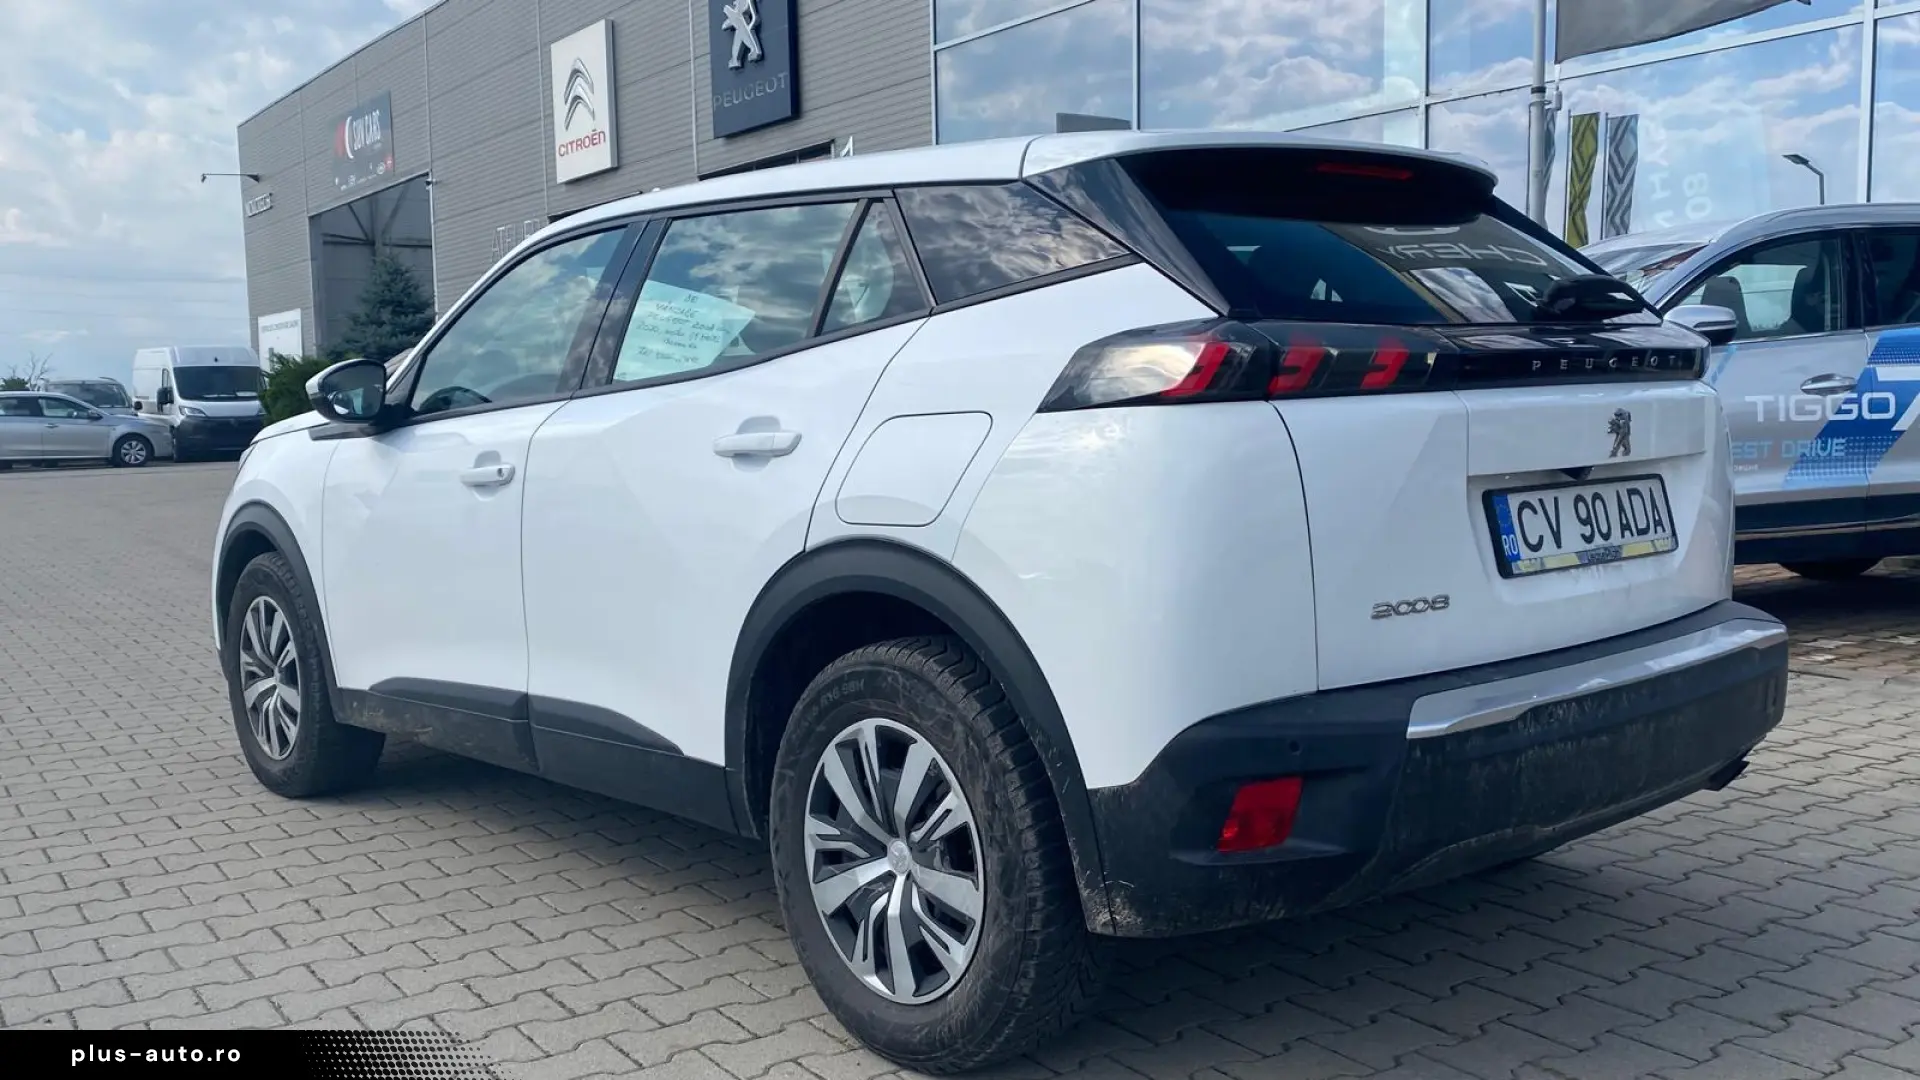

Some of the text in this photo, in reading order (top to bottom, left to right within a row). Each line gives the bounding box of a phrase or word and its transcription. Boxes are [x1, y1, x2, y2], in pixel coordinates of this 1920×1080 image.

[713, 71, 788, 111] PEUGEOT
[1532, 355, 1676, 371] PEUGEOT
[1745, 391, 1896, 422] TIGGO
[1732, 436, 1847, 459] EST DRIVE
[1517, 486, 1666, 552] CV 90 ADA
[1502, 534, 1519, 556] RO
[1371, 594, 1450, 619] 2008
